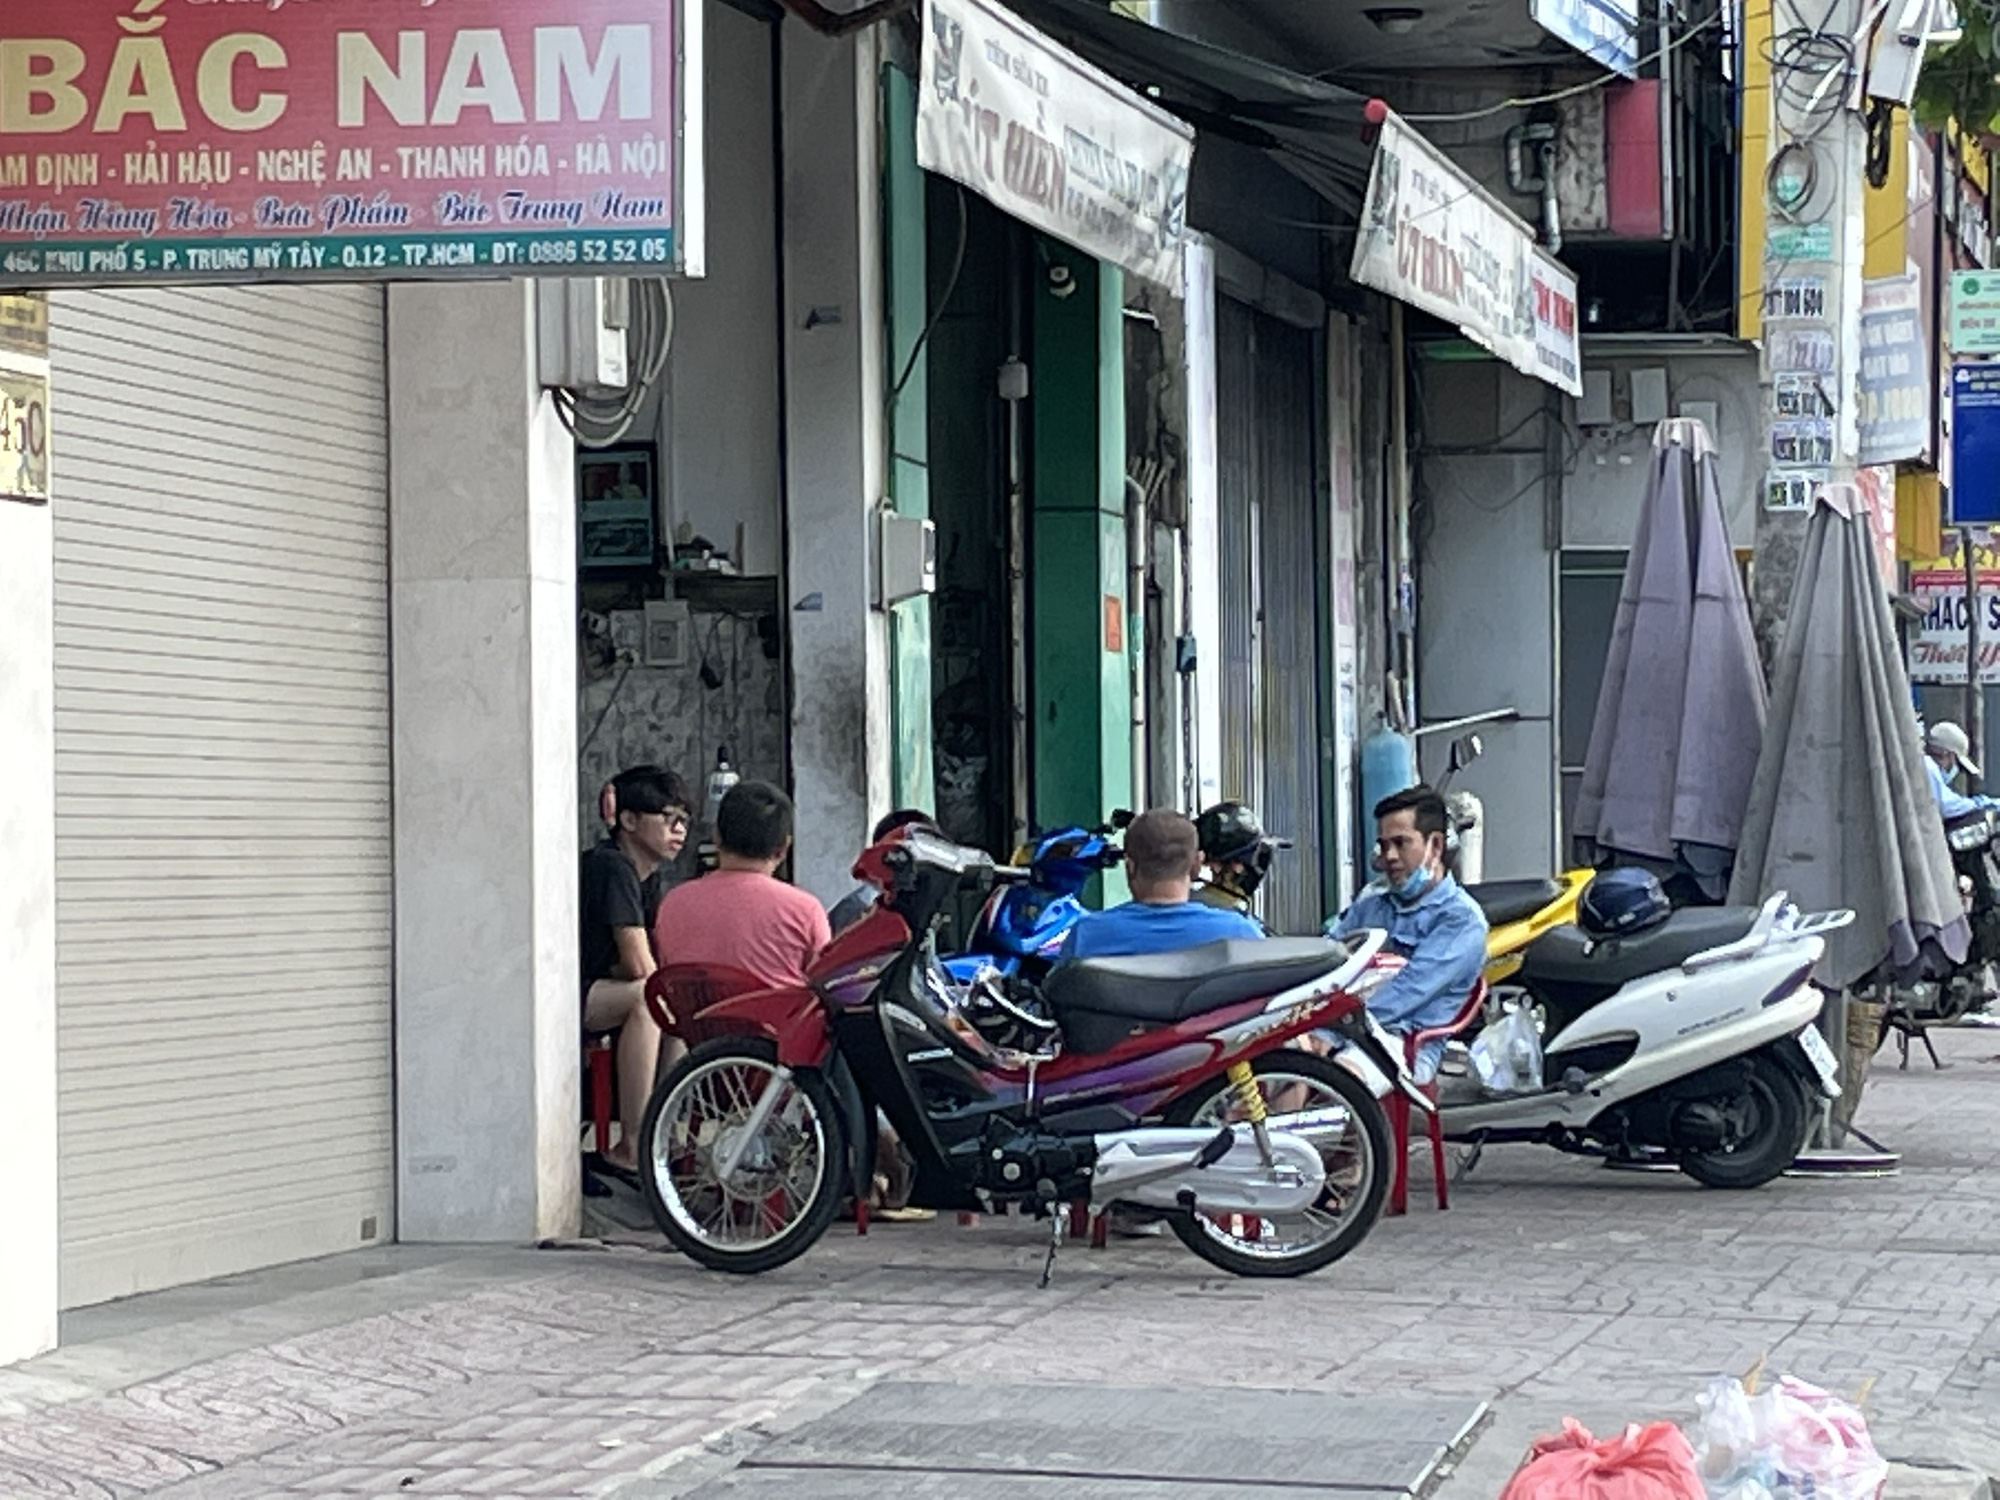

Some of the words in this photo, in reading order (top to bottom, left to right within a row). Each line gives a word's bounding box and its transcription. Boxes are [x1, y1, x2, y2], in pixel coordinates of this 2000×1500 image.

[0, 0, 288, 133] BẮC
[337, 24, 652, 127] NAM
[124, 141, 169, 185] HẢI
[178, 144, 231, 190] HẬU
[257, 141, 326, 188] NGHỆ
[336, 148, 372, 181] AN
[396, 143, 486, 180] THANH
[495, 135, 550, 178] HÓA
[575, 134, 612, 175] HÀ
[621, 132, 666, 179] NỘI
[499, 189, 588, 229] Trung
[591, 184, 668, 224] Nam
[45, 251, 84, 272] KHU
[89, 240, 130, 272] PHỐ
[187, 248, 249, 270] TRUNG
[253, 240, 283, 268] MỸ
[288, 240, 326, 268] TÂY
[402, 242, 475, 266] TP.HCM
[582, 239, 607, 261] 52
[612, 239, 637, 261] 52
[641, 238, 667, 261] 05
